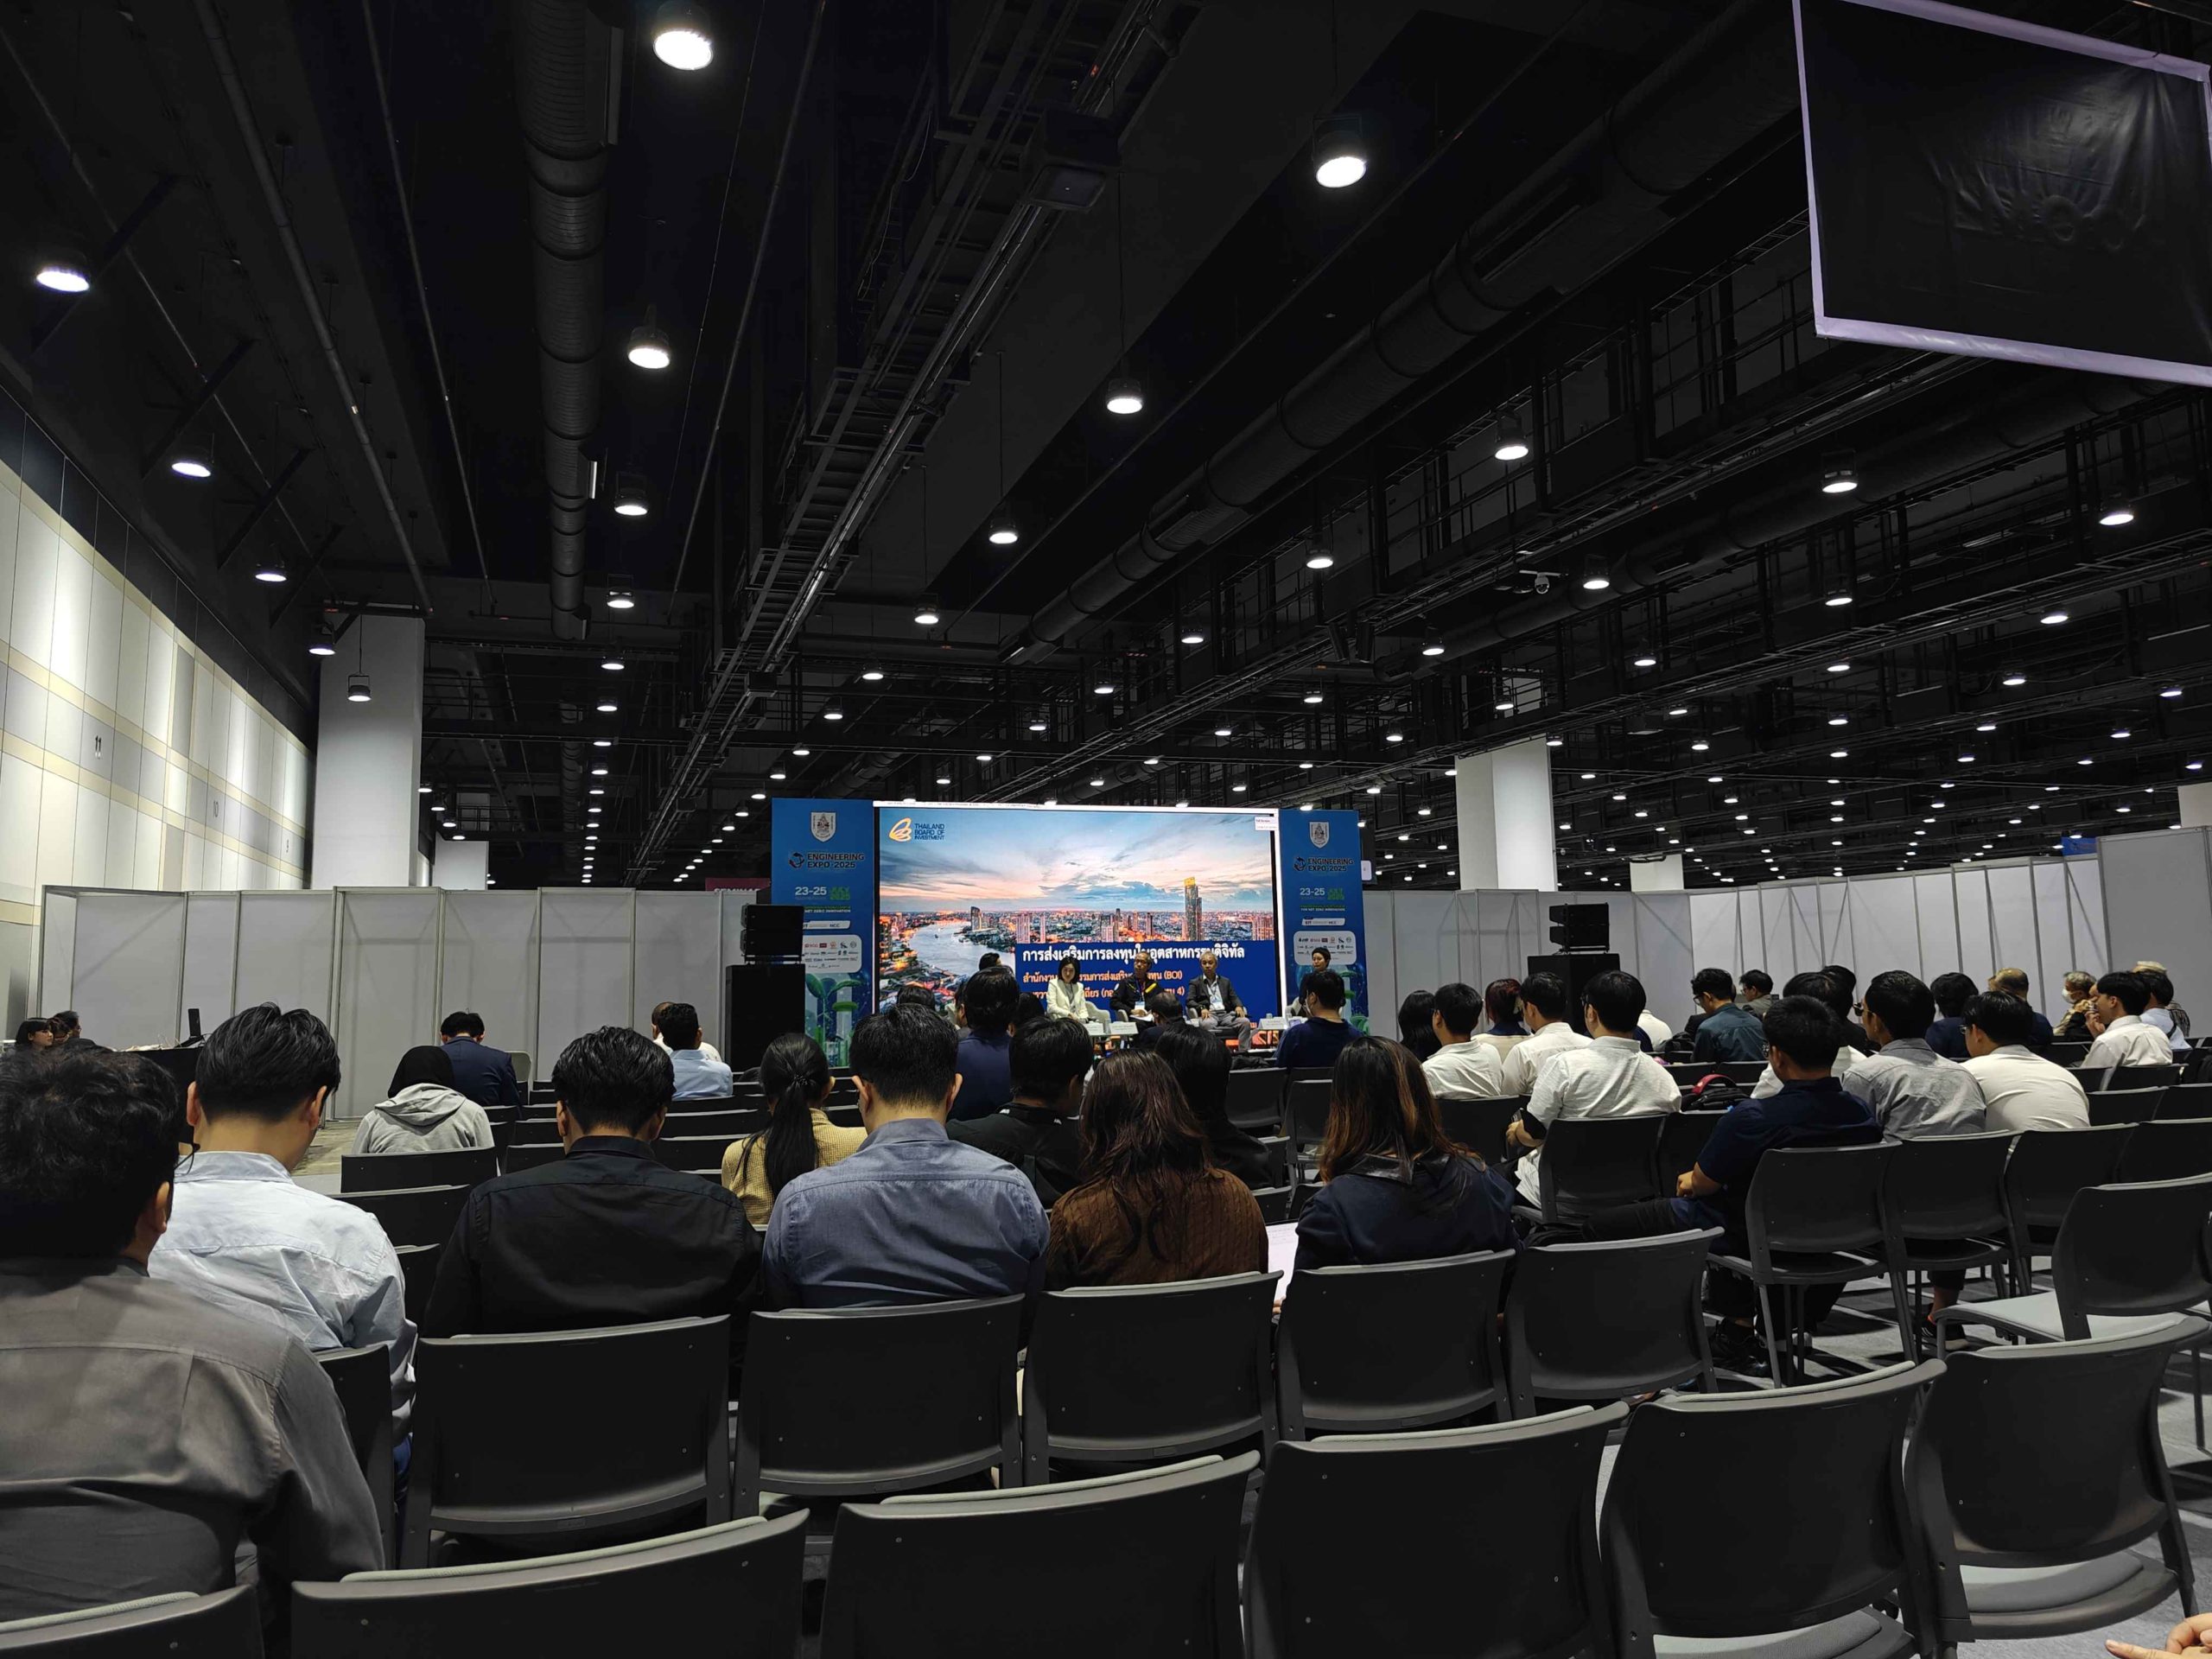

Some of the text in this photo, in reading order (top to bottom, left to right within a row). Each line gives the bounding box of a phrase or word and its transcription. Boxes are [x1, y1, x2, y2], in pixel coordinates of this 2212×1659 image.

[795, 887, 827, 896] 23-25
[1300, 887, 1325, 896] 23-25
[1163, 969, 1183, 980] (BOI)
